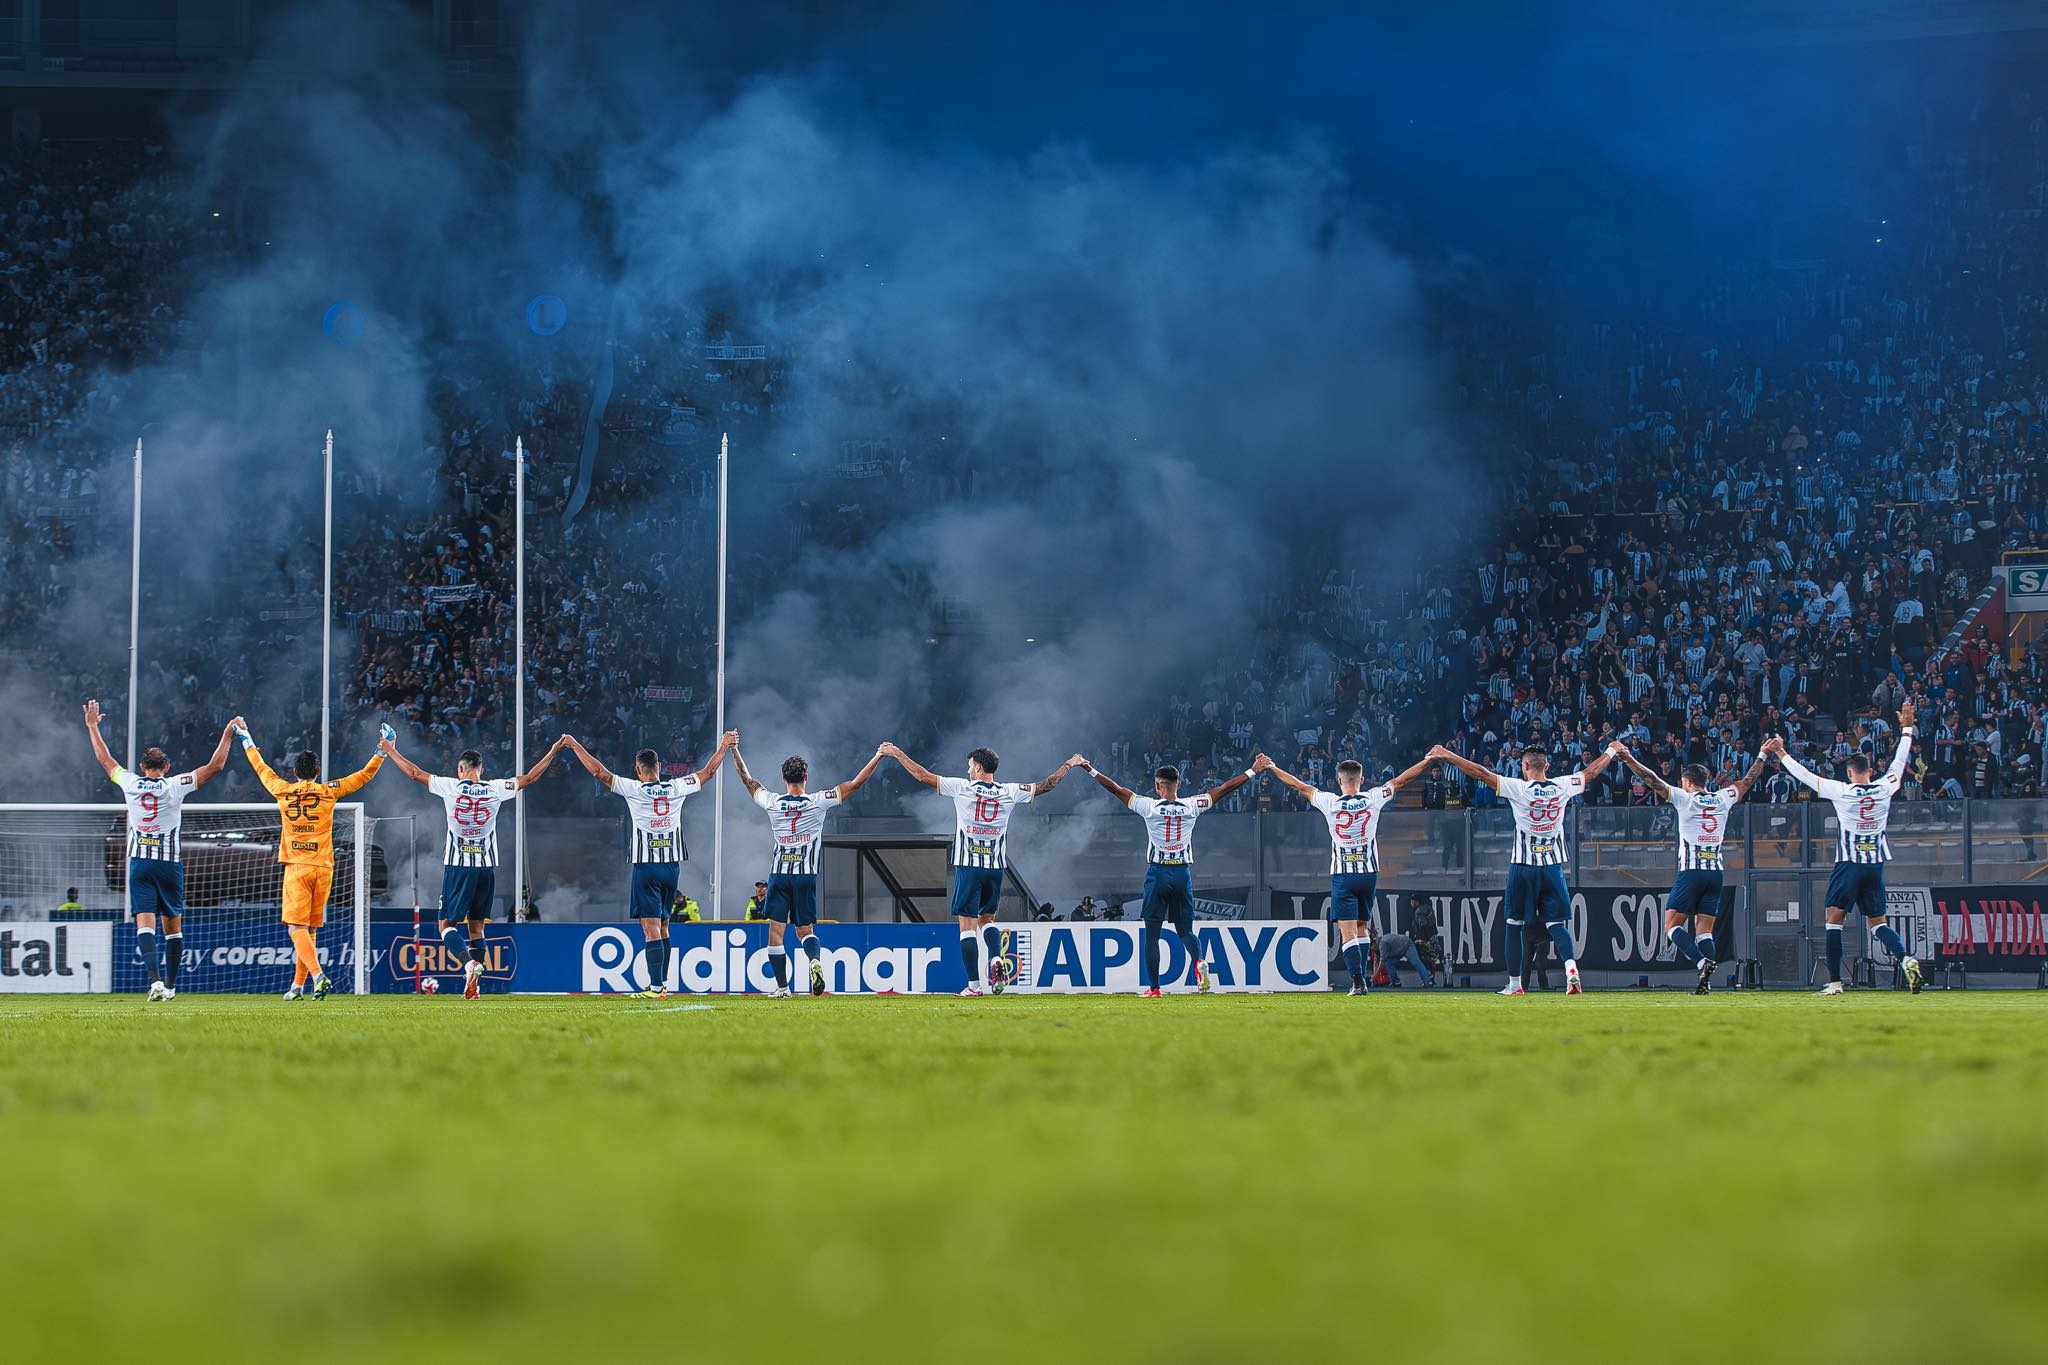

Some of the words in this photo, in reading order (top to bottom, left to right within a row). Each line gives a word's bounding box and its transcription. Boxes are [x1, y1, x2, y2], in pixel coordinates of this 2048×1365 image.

[469, 788, 488, 796] bitel
[141, 792, 158, 822] 9
[285, 793, 321, 822] 32
[455, 795, 491, 826] 26
[975, 793, 1000, 822] 10
[1349, 801, 1367, 811] bitel
[1860, 796, 1875, 821] 2
[785, 810, 802, 834] 7
[1164, 816, 1182, 842] 11
[1335, 810, 1371, 839] 27
[1702, 807, 1718, 834] 5
[139, 838, 161, 846] CRISTAL
[293, 842, 317, 851] CRISTAL
[461, 845, 483, 853] CRISTAL
[650, 840, 672, 848] CRISTAL
[970, 846, 992, 855] CRISTAL
[1532, 845, 1553, 853] CRISTAL
[1886, 893, 1919, 901] IANZA
[1429, 896, 1503, 964] HAY
[1611, 894, 1692, 962] SOL
[1918, 916, 1926, 943] LIMA
[1937, 900, 1976, 955] LA
[1979, 900, 2048, 956] VIDA
[212, 946, 334, 967] corazn,
[339, 943, 388, 973] hy
[399, 944, 509, 972] CRISAL
[582, 927, 942, 992] Radiomar
[1037, 927, 1321, 988] APDAYC
